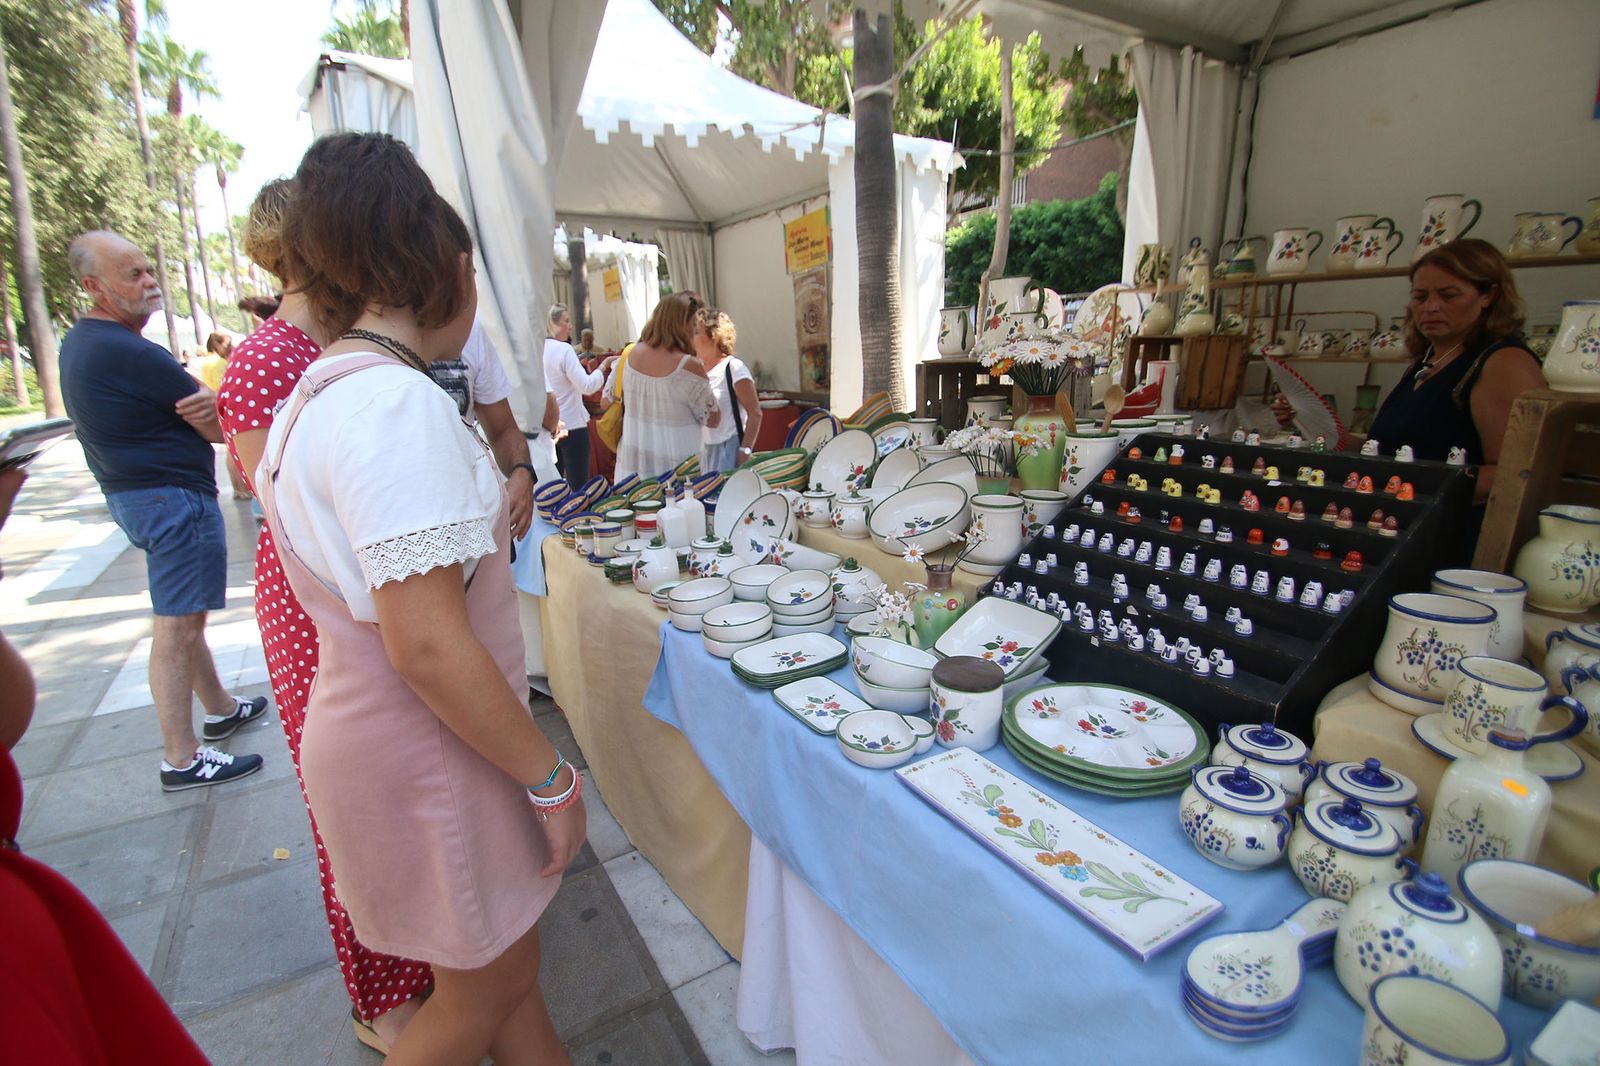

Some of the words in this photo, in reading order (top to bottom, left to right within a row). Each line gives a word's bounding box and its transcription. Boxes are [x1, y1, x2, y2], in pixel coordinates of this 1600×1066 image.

[1161, 646, 1172, 658] N
[1187, 649, 1197, 660] C
[1209, 651, 1218, 662] S
[1193, 659, 1200, 670] L
[240, 705, 252, 719] N
[196, 763, 221, 779] N
